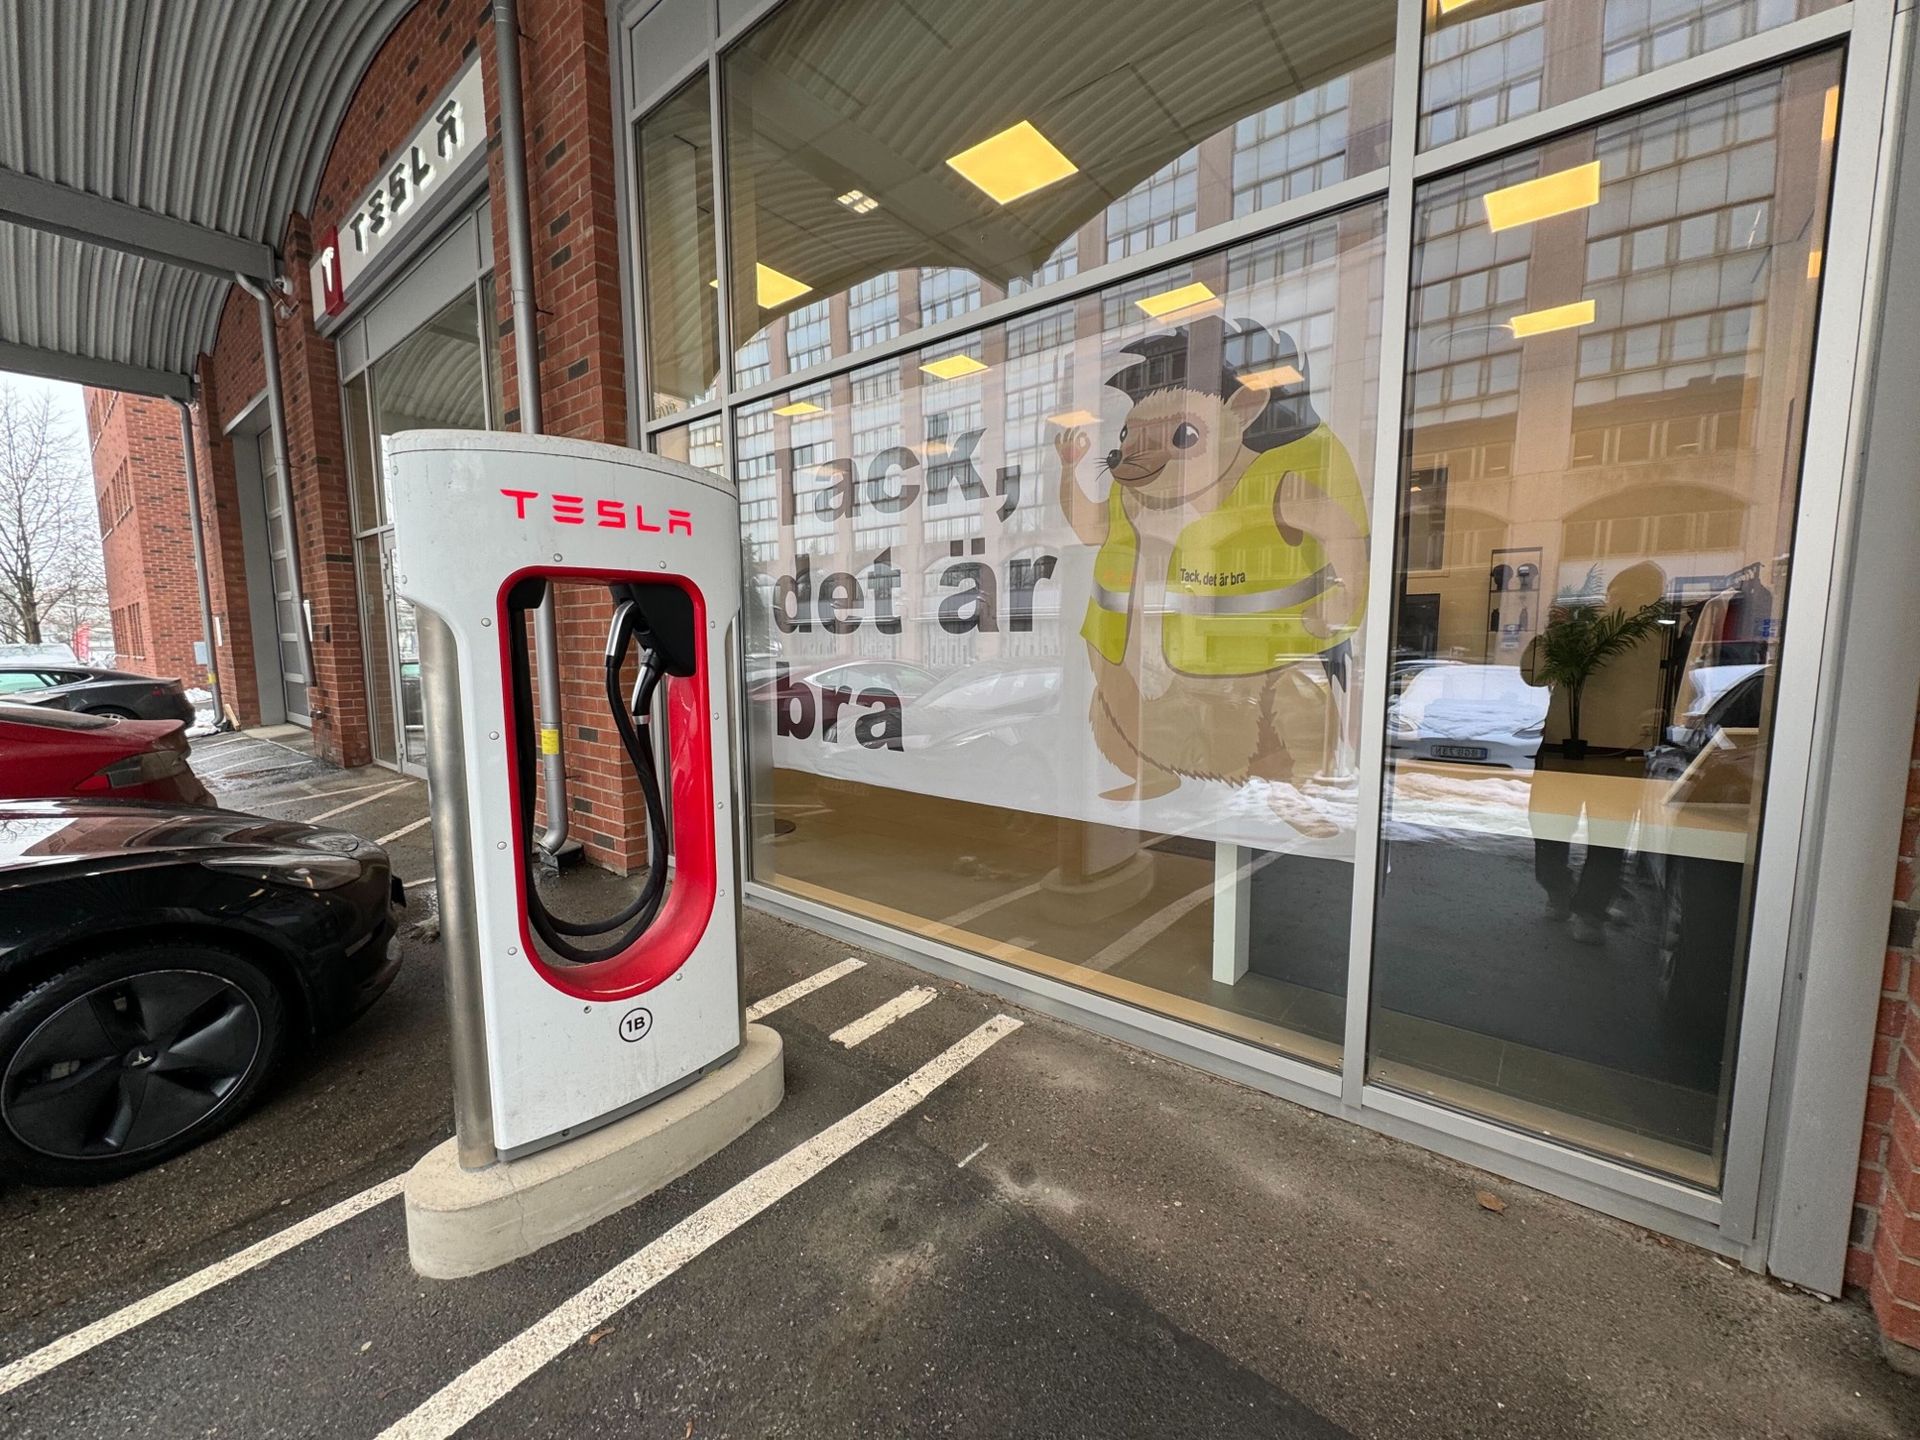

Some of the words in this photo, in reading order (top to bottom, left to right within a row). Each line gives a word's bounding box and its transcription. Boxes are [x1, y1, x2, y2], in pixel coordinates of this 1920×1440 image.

[350, 99, 463, 254] TESLA
[500, 489, 692, 536] TESLA
[772, 546, 903, 635] det
[938, 537, 1058, 635] är
[1180, 568, 1202, 585] Tack,
[1203, 572, 1218, 587] det
[1219, 571, 1229, 587] är
[1230, 571, 1246, 586] bra
[775, 661, 905, 752] bra
[626, 1016, 645, 1033] 1B
